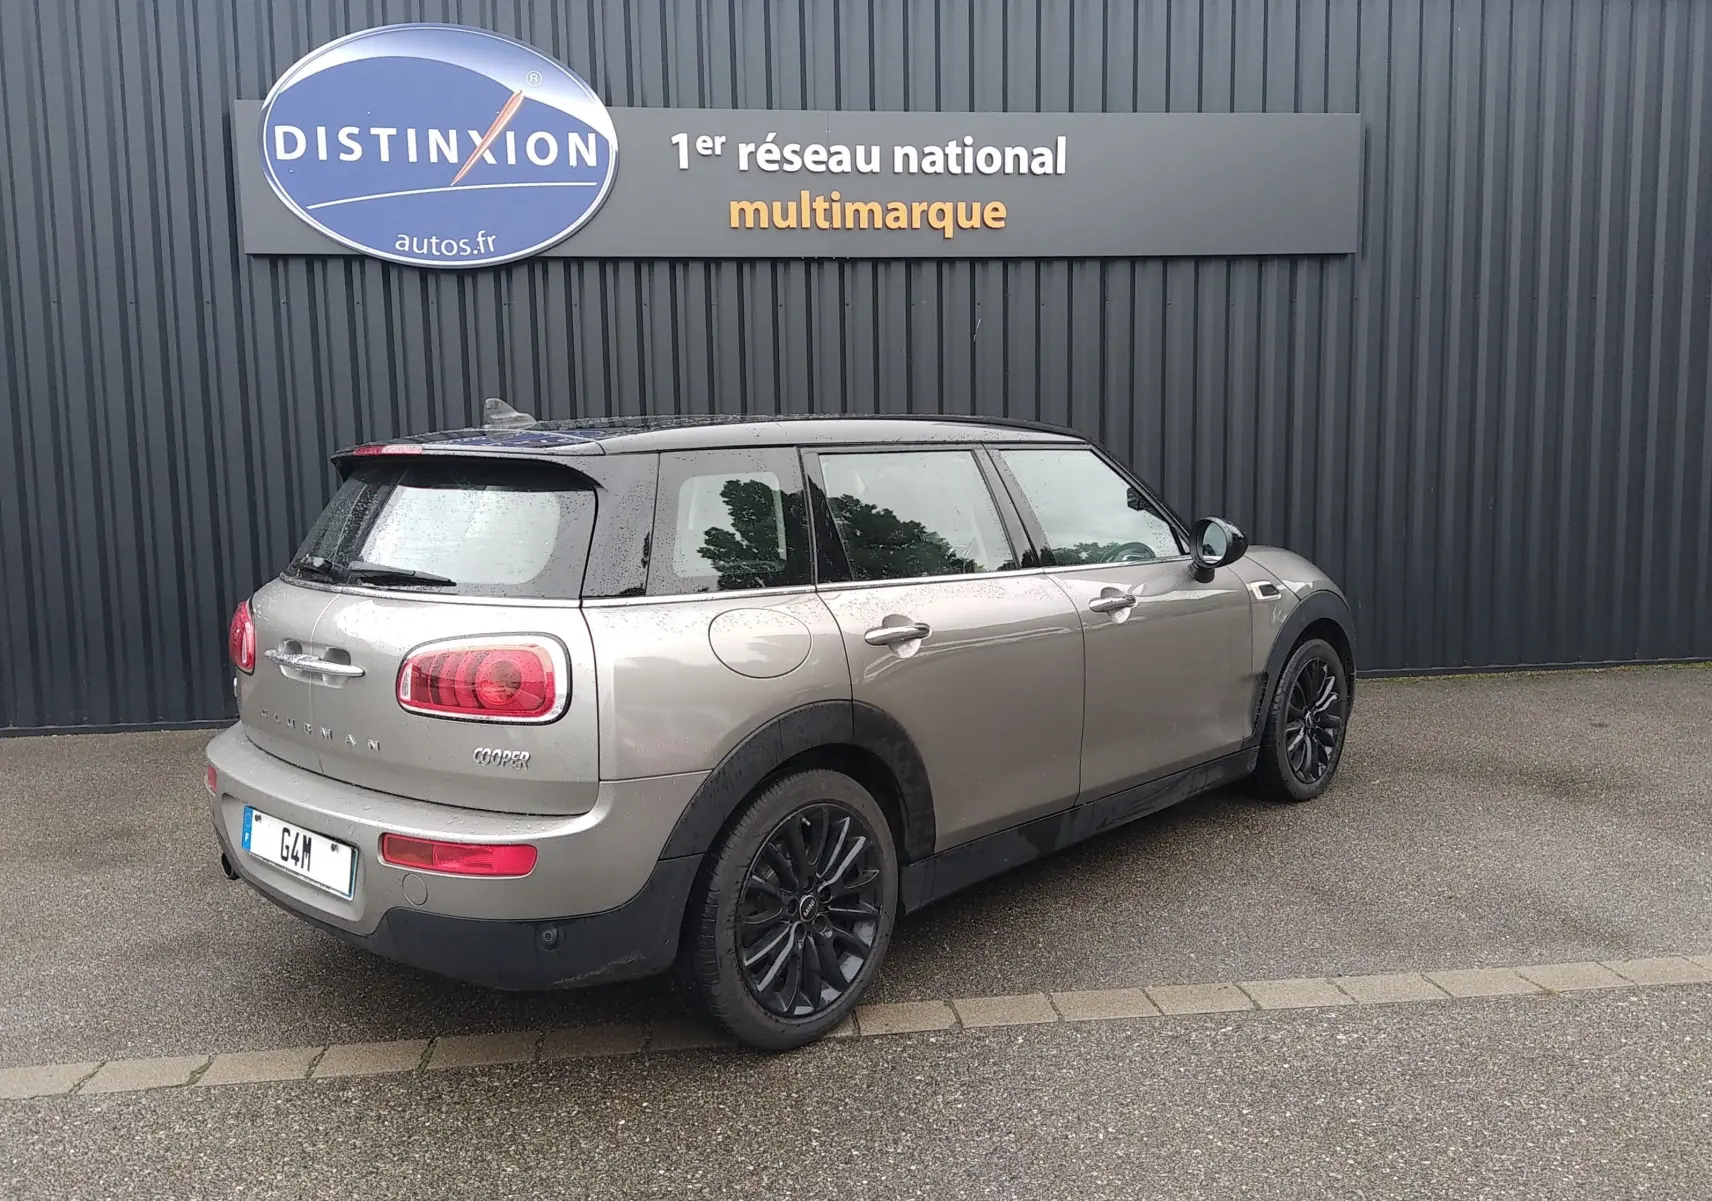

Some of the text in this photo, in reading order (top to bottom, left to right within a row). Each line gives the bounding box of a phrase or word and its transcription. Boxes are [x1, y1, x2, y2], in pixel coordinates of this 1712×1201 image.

[274, 125, 598, 168] DISTINXION
[670, 132, 1067, 175] 1er réseau national
[729, 190, 1007, 239] multimarque
[394, 229, 497, 256] autos.fr
[472, 747, 531, 771] COOPER
[280, 827, 312, 872] G4M
[803, 899, 816, 918] MINI
